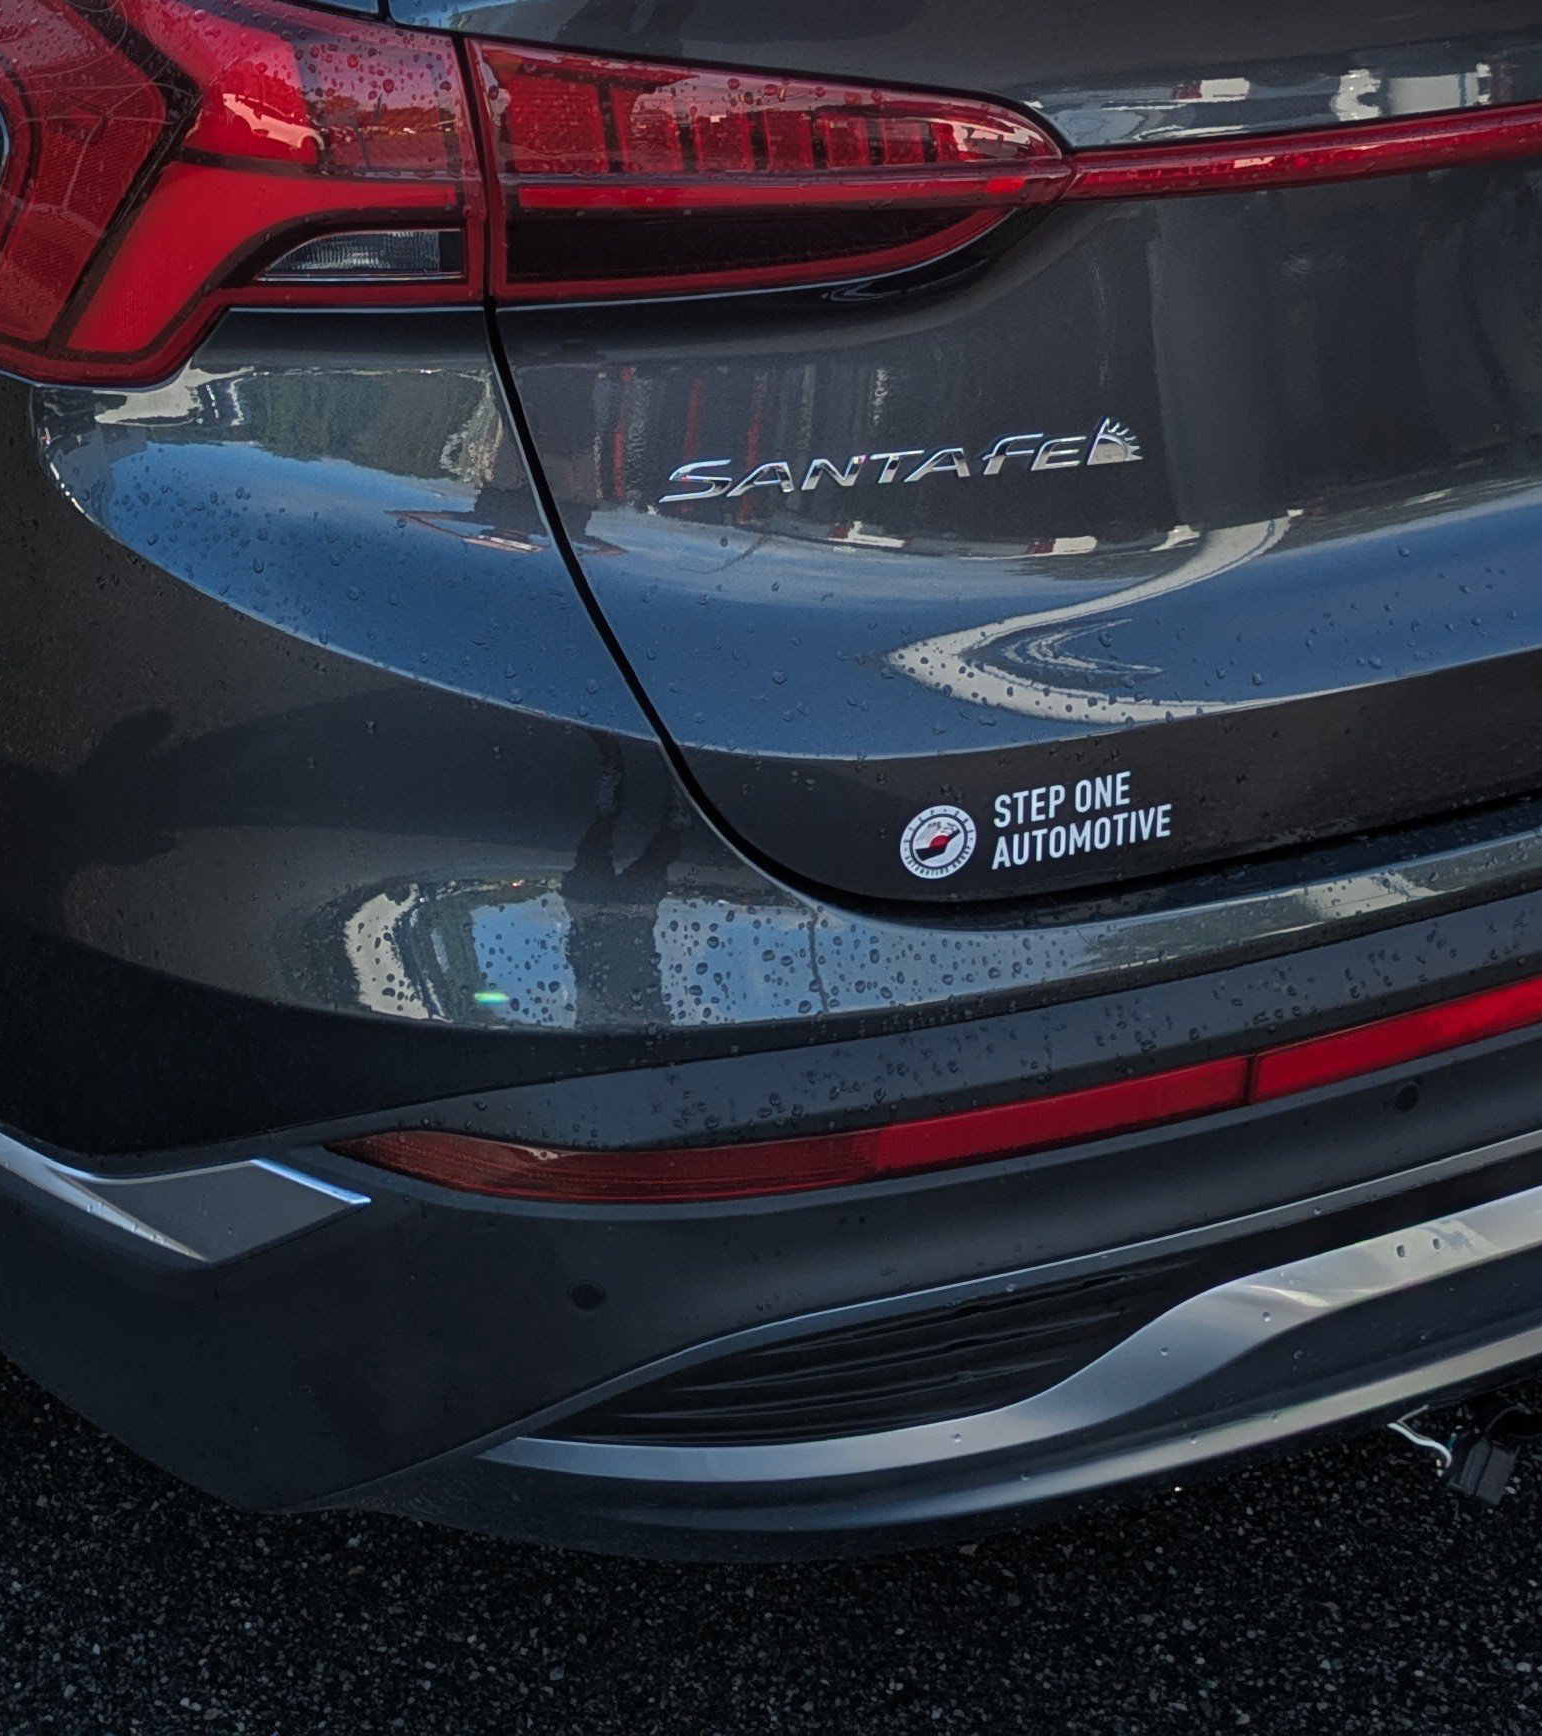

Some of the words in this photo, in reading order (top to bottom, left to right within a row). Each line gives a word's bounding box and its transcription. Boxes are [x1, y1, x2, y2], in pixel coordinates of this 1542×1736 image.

[658, 446, 972, 503] SANTA
[983, 432, 1087, 476] FE
[993, 784, 1066, 828] STEP
[1074, 771, 1131, 813] ONE
[991, 803, 1172, 870] AUTOMOTIVE
